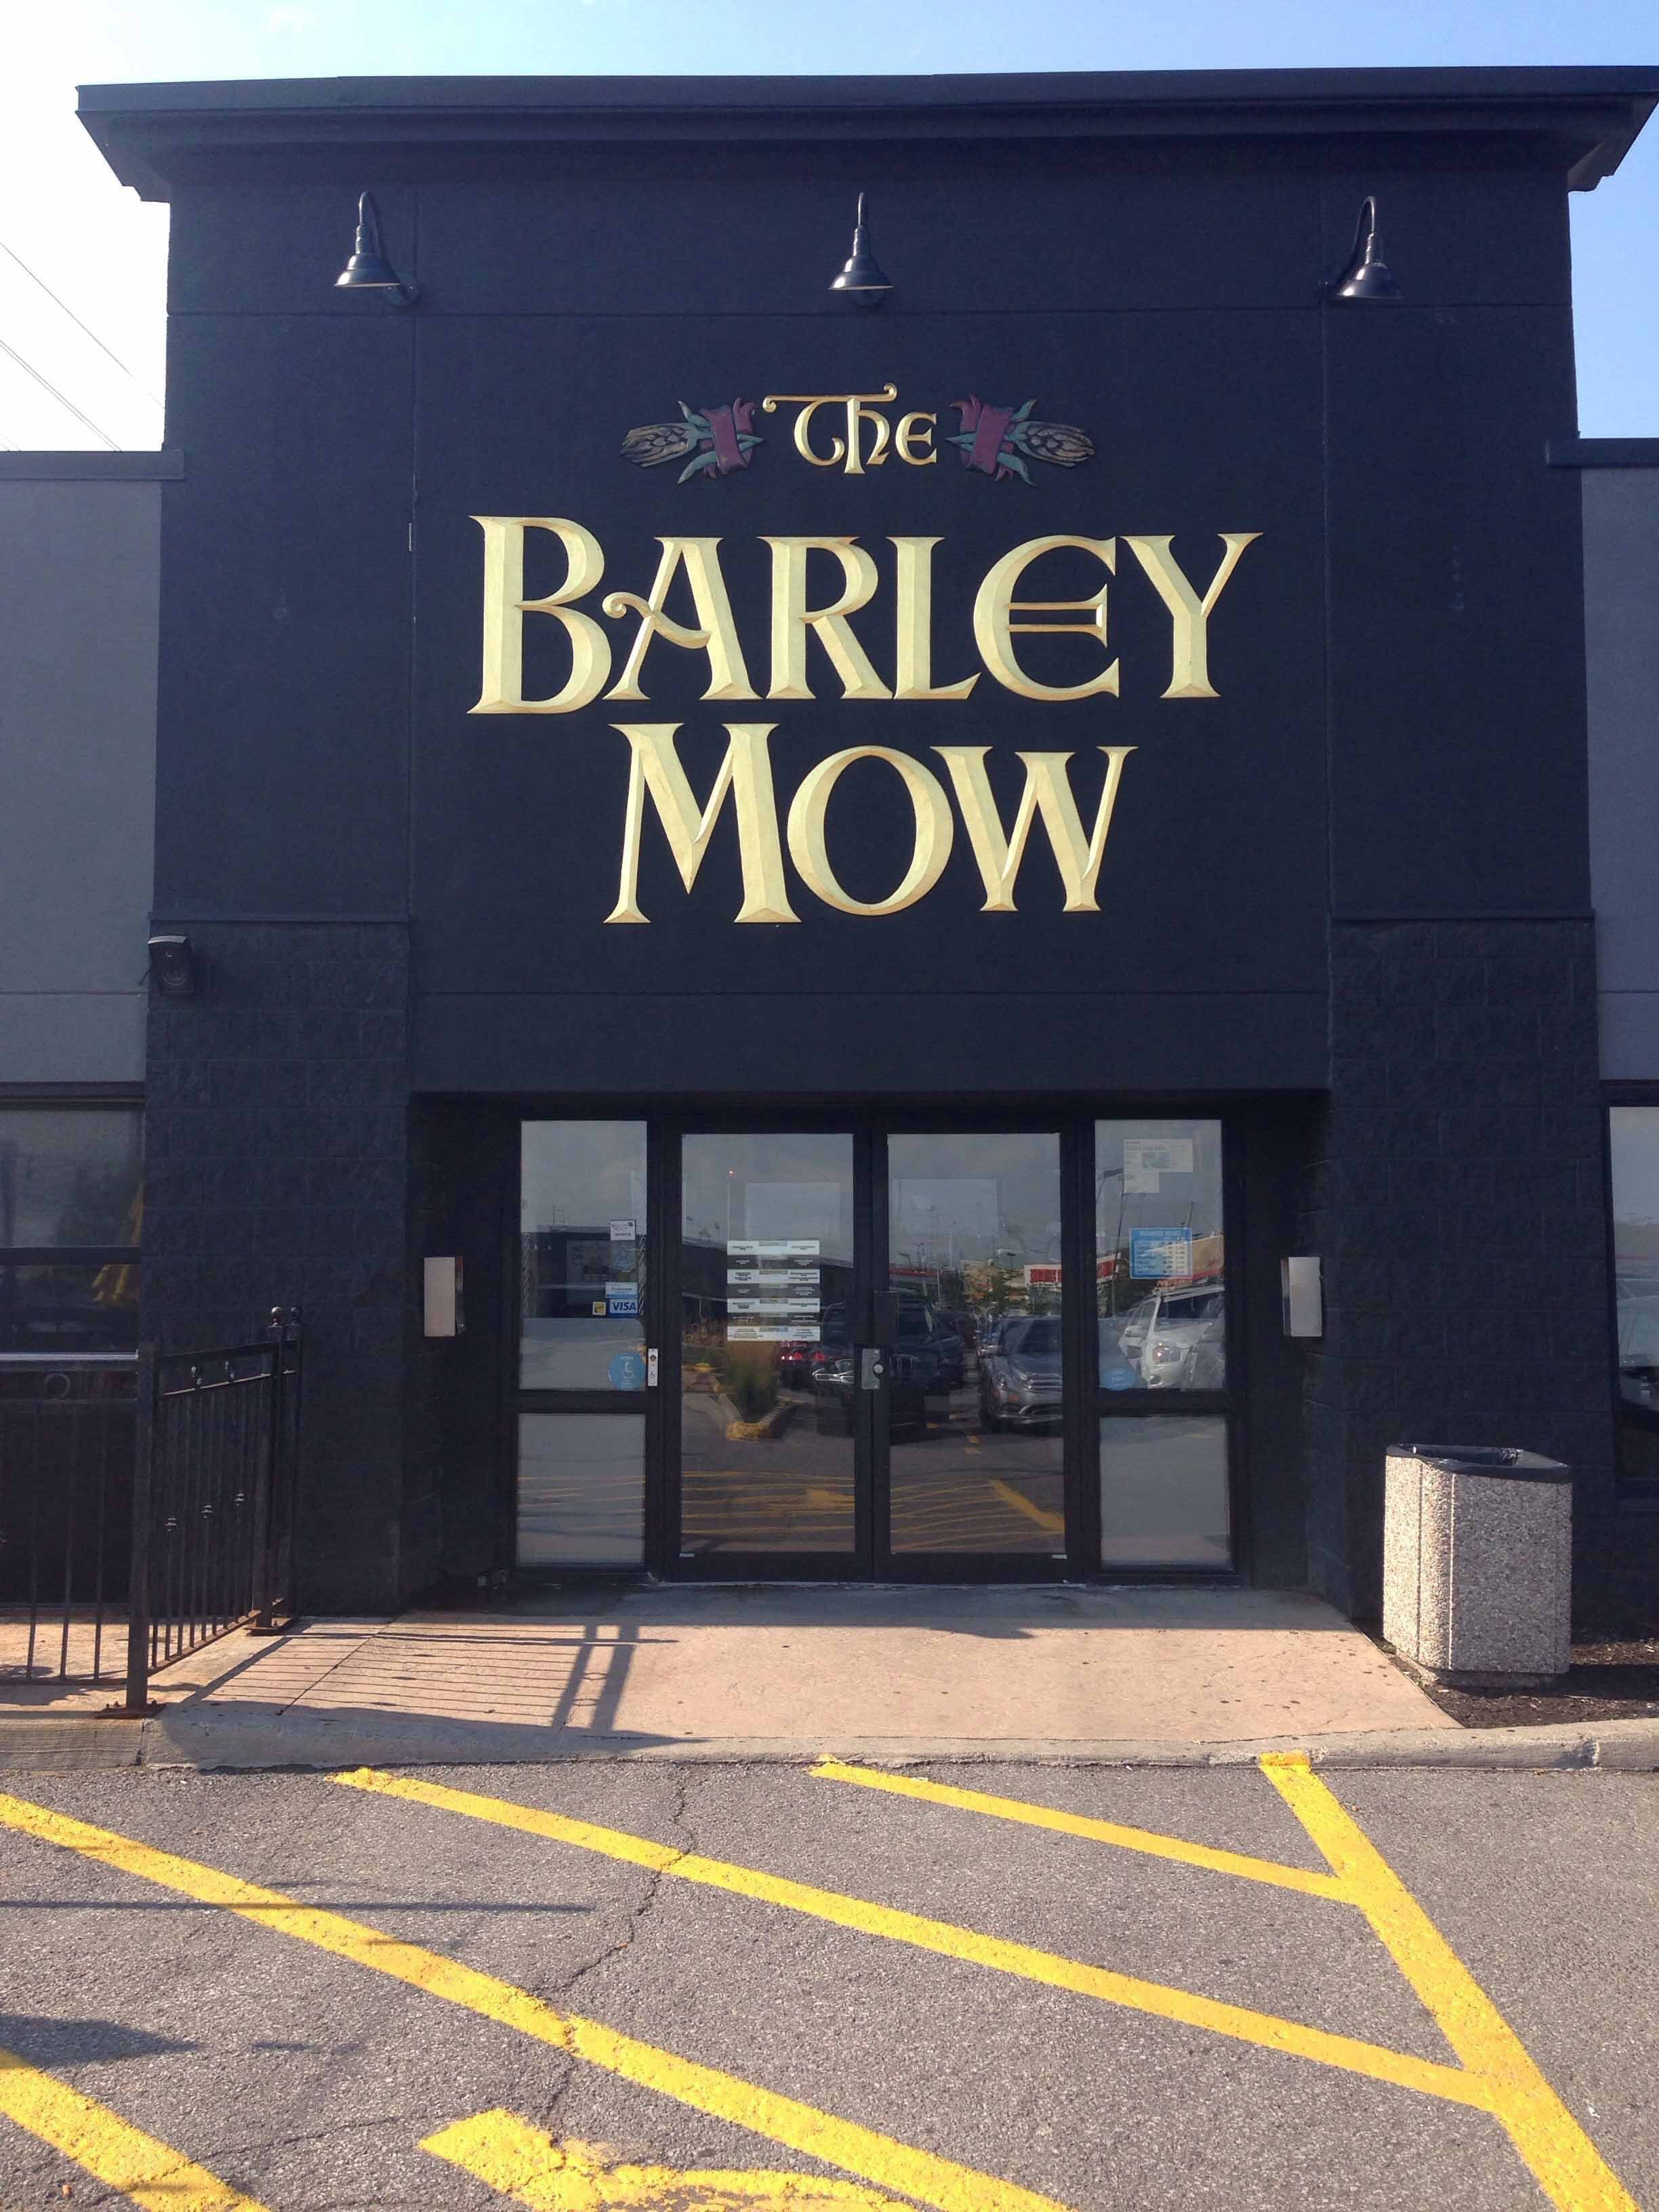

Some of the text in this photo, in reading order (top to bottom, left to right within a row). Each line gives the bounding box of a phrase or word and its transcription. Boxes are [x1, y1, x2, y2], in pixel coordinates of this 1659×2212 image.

[466, 514, 1265, 715] BARLEY
[602, 722, 1139, 925] MOW
[613, 1301, 636, 1311] VISA
